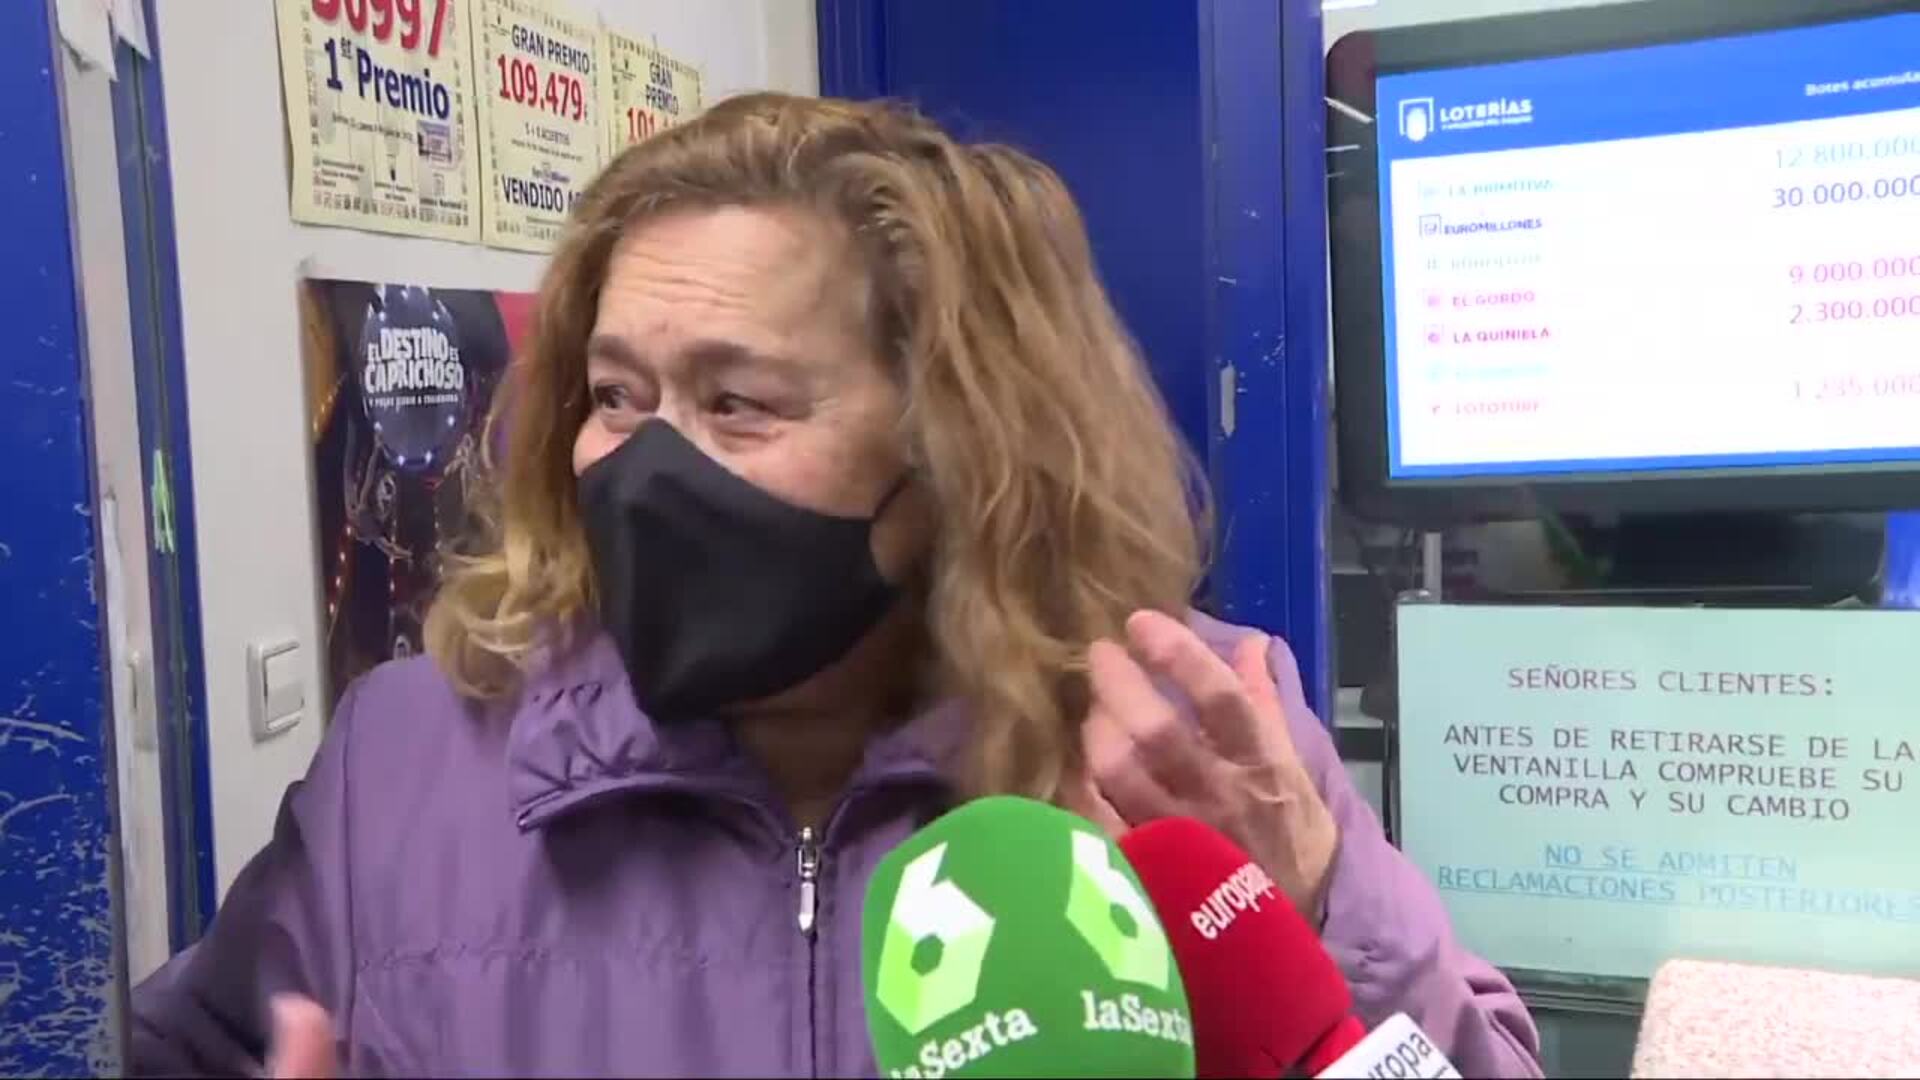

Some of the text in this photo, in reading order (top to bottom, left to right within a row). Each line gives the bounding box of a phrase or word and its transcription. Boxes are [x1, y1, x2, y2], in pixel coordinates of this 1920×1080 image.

[511, 24, 590, 75] GRAN PREMIO
[356, 48, 450, 120] Premio
[649, 62, 673, 90] GRAN
[1440, 97, 1534, 124] LOTERÍAS
[501, 174, 563, 212] VENDIDO
[1444, 218, 1543, 235] EUROMILLONES
[367, 343, 382, 363] EL
[381, 327, 449, 361] DESTINO
[1453, 332, 1471, 344] LA
[1476, 328, 1550, 343] QUINIELA
[364, 358, 465, 394] CAPRICHOSO
[1508, 664, 1835, 697] SEÑORES CLIENTES:
[1444, 724, 1917, 762] ANTES DE RETIRARSE DE LA
[1453, 753, 1904, 794] VENTANILLA COMPRUEBE SU
[1499, 783, 1851, 822] COMPRA Y SU CAMBIO
[1545, 844, 1798, 881] NO SE ADMITEN
[1438, 865, 1677, 900] RECLAMACIONES
